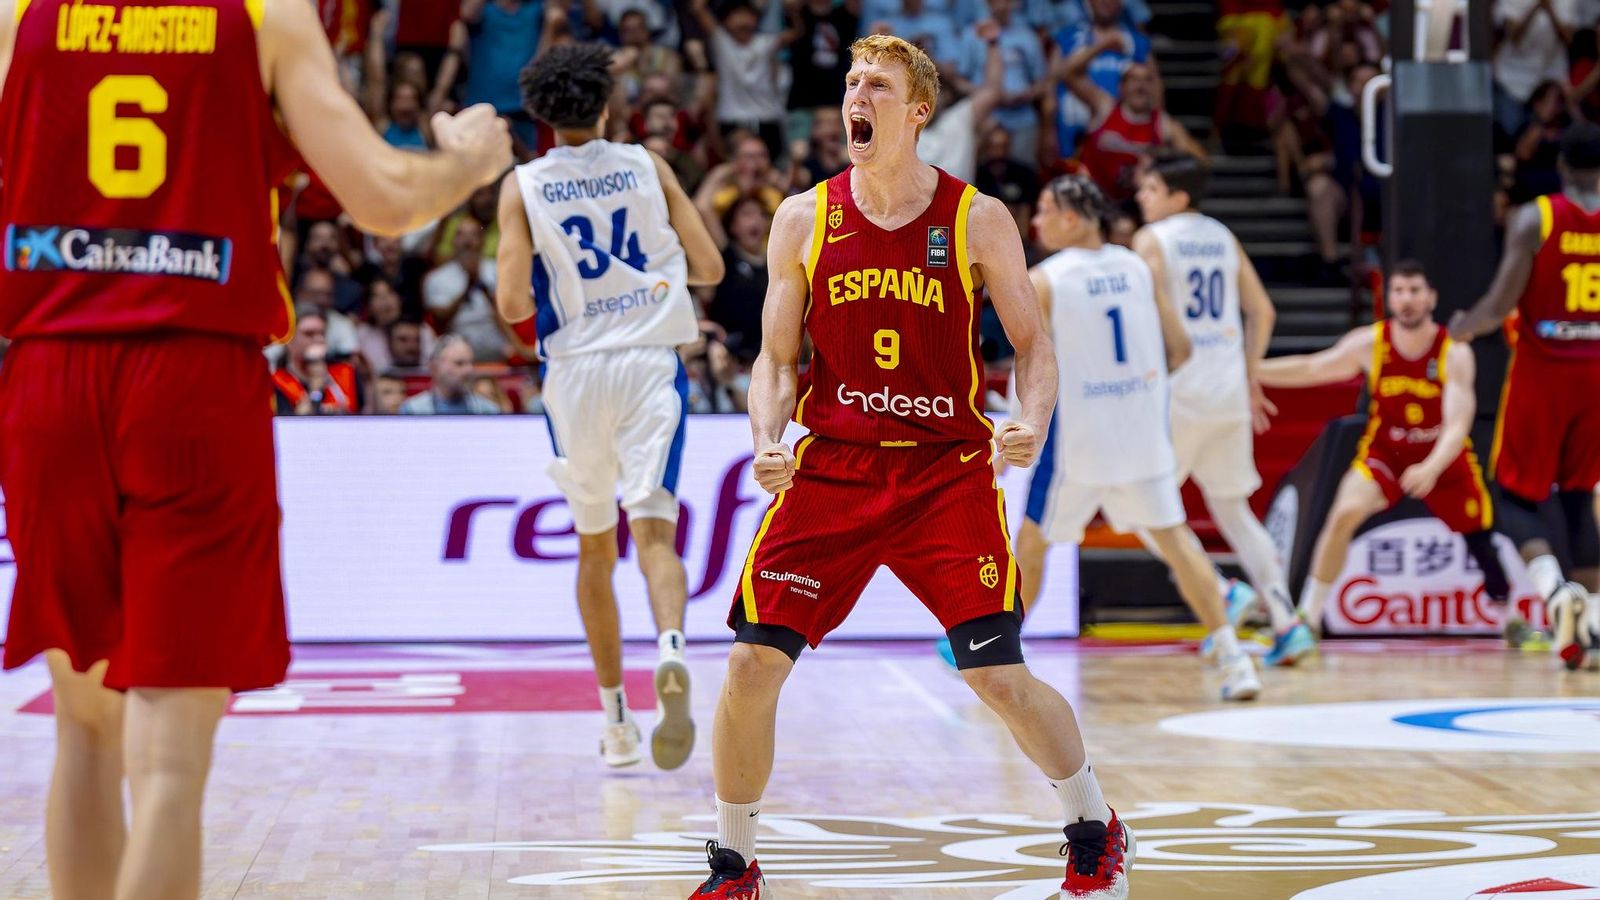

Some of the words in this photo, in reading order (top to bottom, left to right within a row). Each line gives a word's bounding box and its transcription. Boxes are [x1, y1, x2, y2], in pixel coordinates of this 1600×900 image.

[88, 75, 168, 198] 6
[543, 170, 638, 202] GRANDISON
[60, 229, 220, 279] CaixaBank
[560, 207, 648, 279] 34
[930, 249, 946, 257] FIBA
[583, 288, 649, 316] stepIT
[828, 267, 945, 313] ESPAÑA
[1186, 268, 1225, 319] 30
[1562, 262, 1600, 312] 16
[873, 329, 900, 370] 9
[1106, 306, 1127, 364] 1
[837, 383, 954, 418] endesa
[1368, 537, 1481, 576] 百岁
[760, 570, 821, 589] azulmarino
